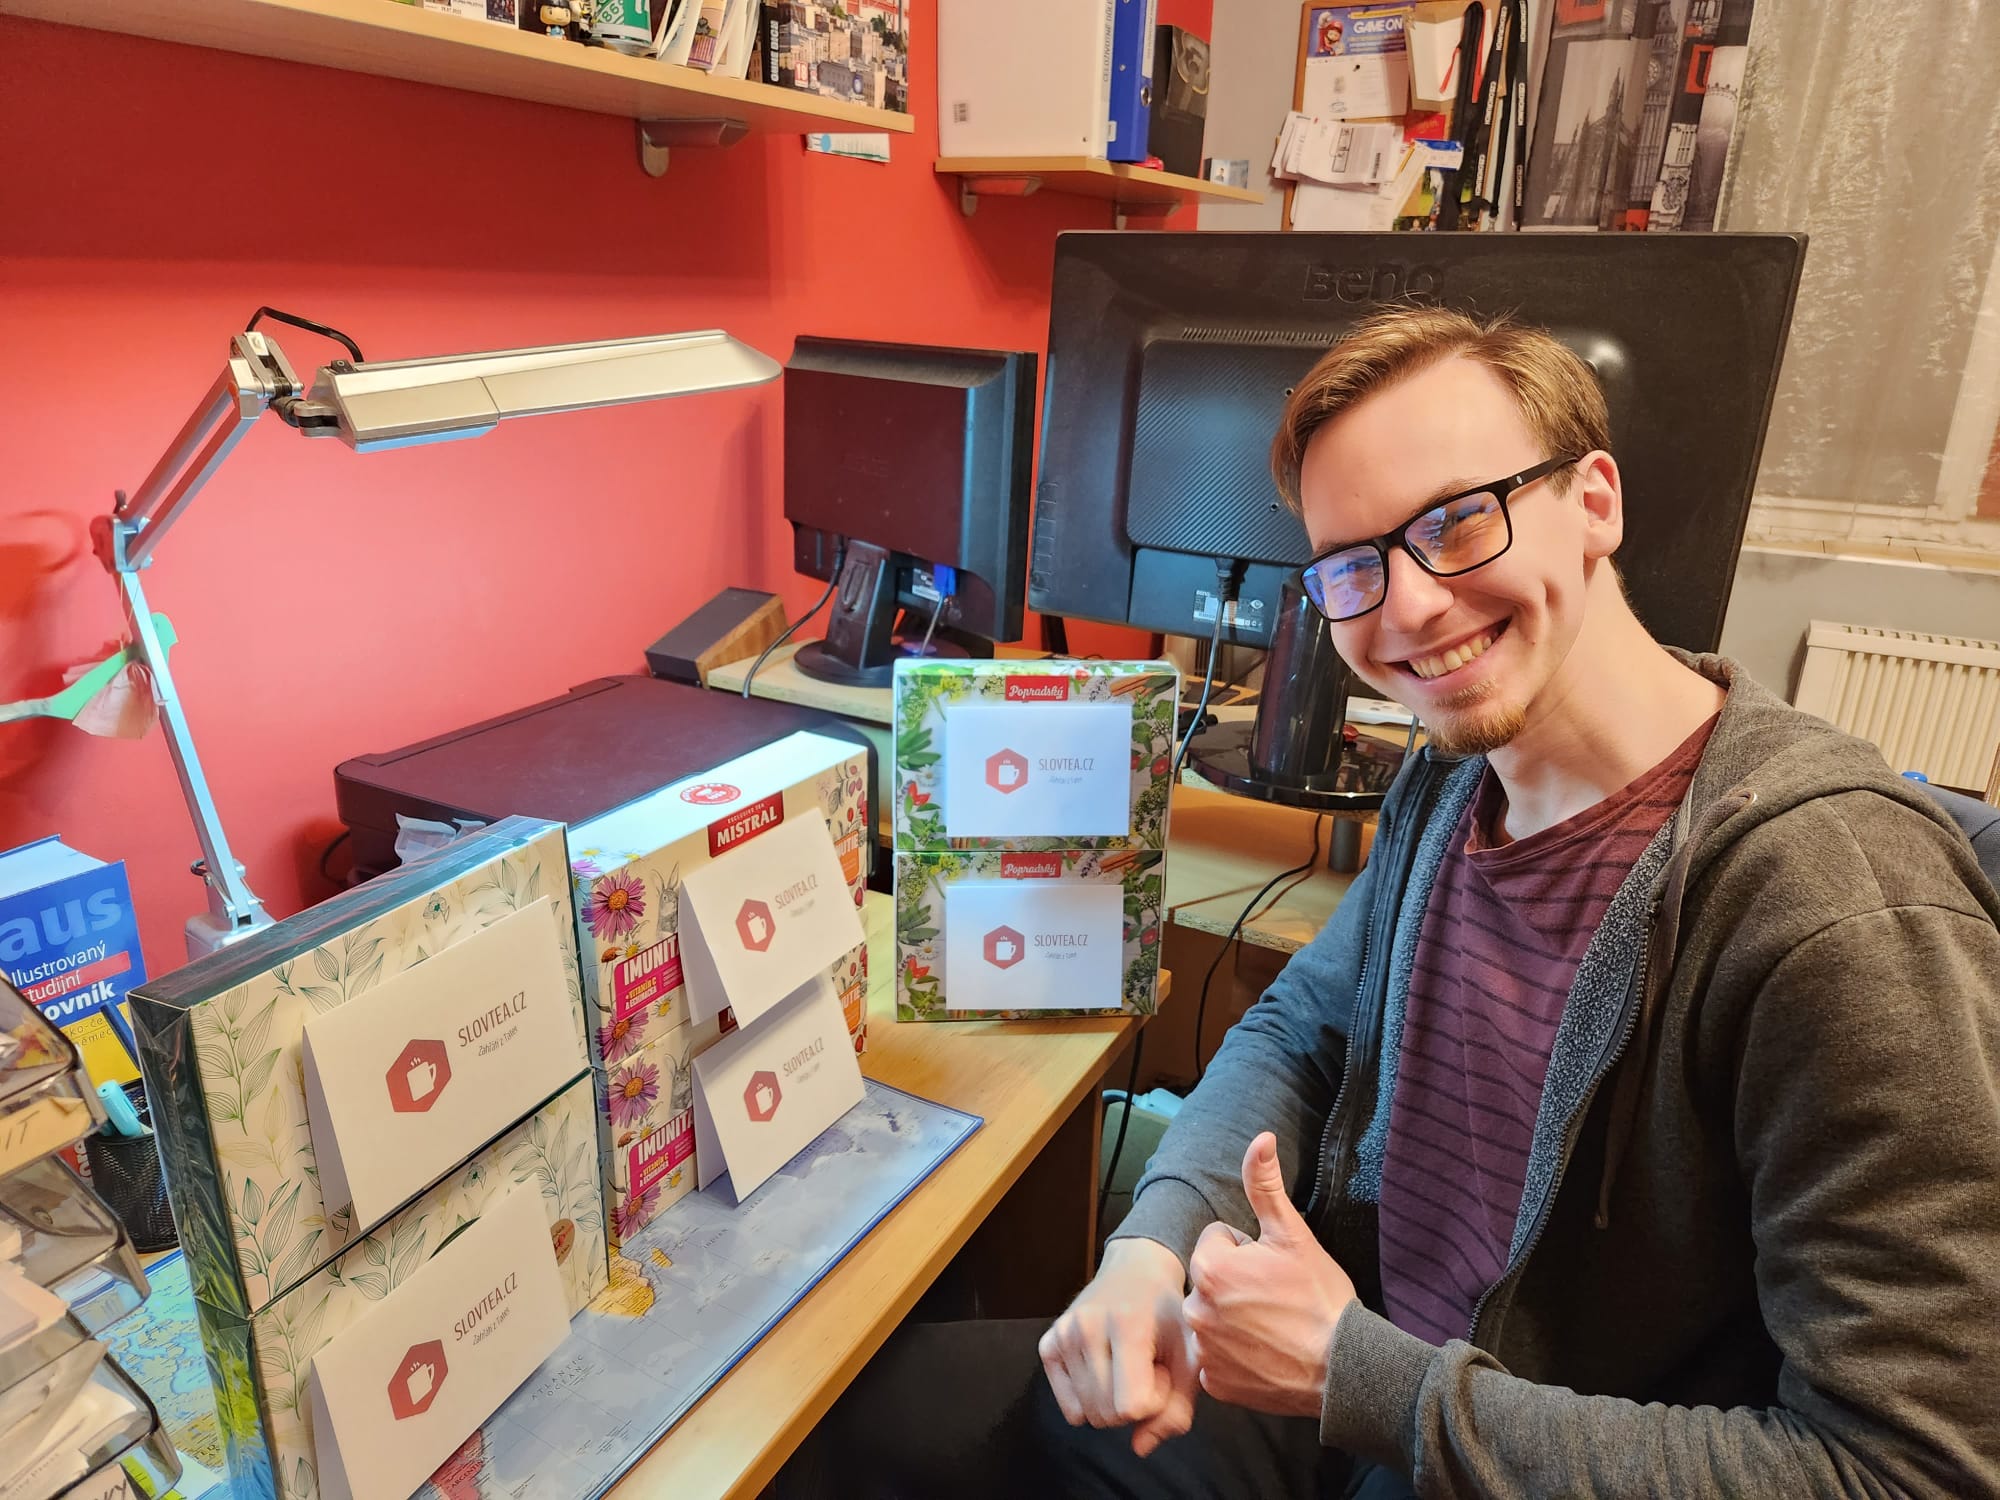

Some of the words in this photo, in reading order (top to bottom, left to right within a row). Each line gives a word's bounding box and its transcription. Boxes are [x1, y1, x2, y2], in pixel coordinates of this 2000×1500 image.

[1353, 20, 1385, 33] GAME
[1385, 18, 1403, 31] ON
[1008, 684, 1064, 700] Popradský
[1039, 758, 1095, 771] SLOVTEA.CZ
[717, 806, 777, 847] MISTRAL
[1004, 863, 1057, 877] Popradský
[775, 873, 819, 909] SLOVTEA.CZ
[623, 934, 680, 986] IMUNIT
[1034, 934, 1089, 947] SLOVTEA.CZ
[11, 940, 106, 987] Ilustrovaný
[36, 981, 116, 1021] ovník
[458, 991, 527, 1048] SLOVTEA.CZ
[783, 1036, 825, 1078] SLOVTEA.CZ
[454, 1271, 519, 1342] SLOVTEA.CZ
[531, 1353, 585, 1401] ATLANTIC
[546, 1366, 583, 1397] OCEAN
